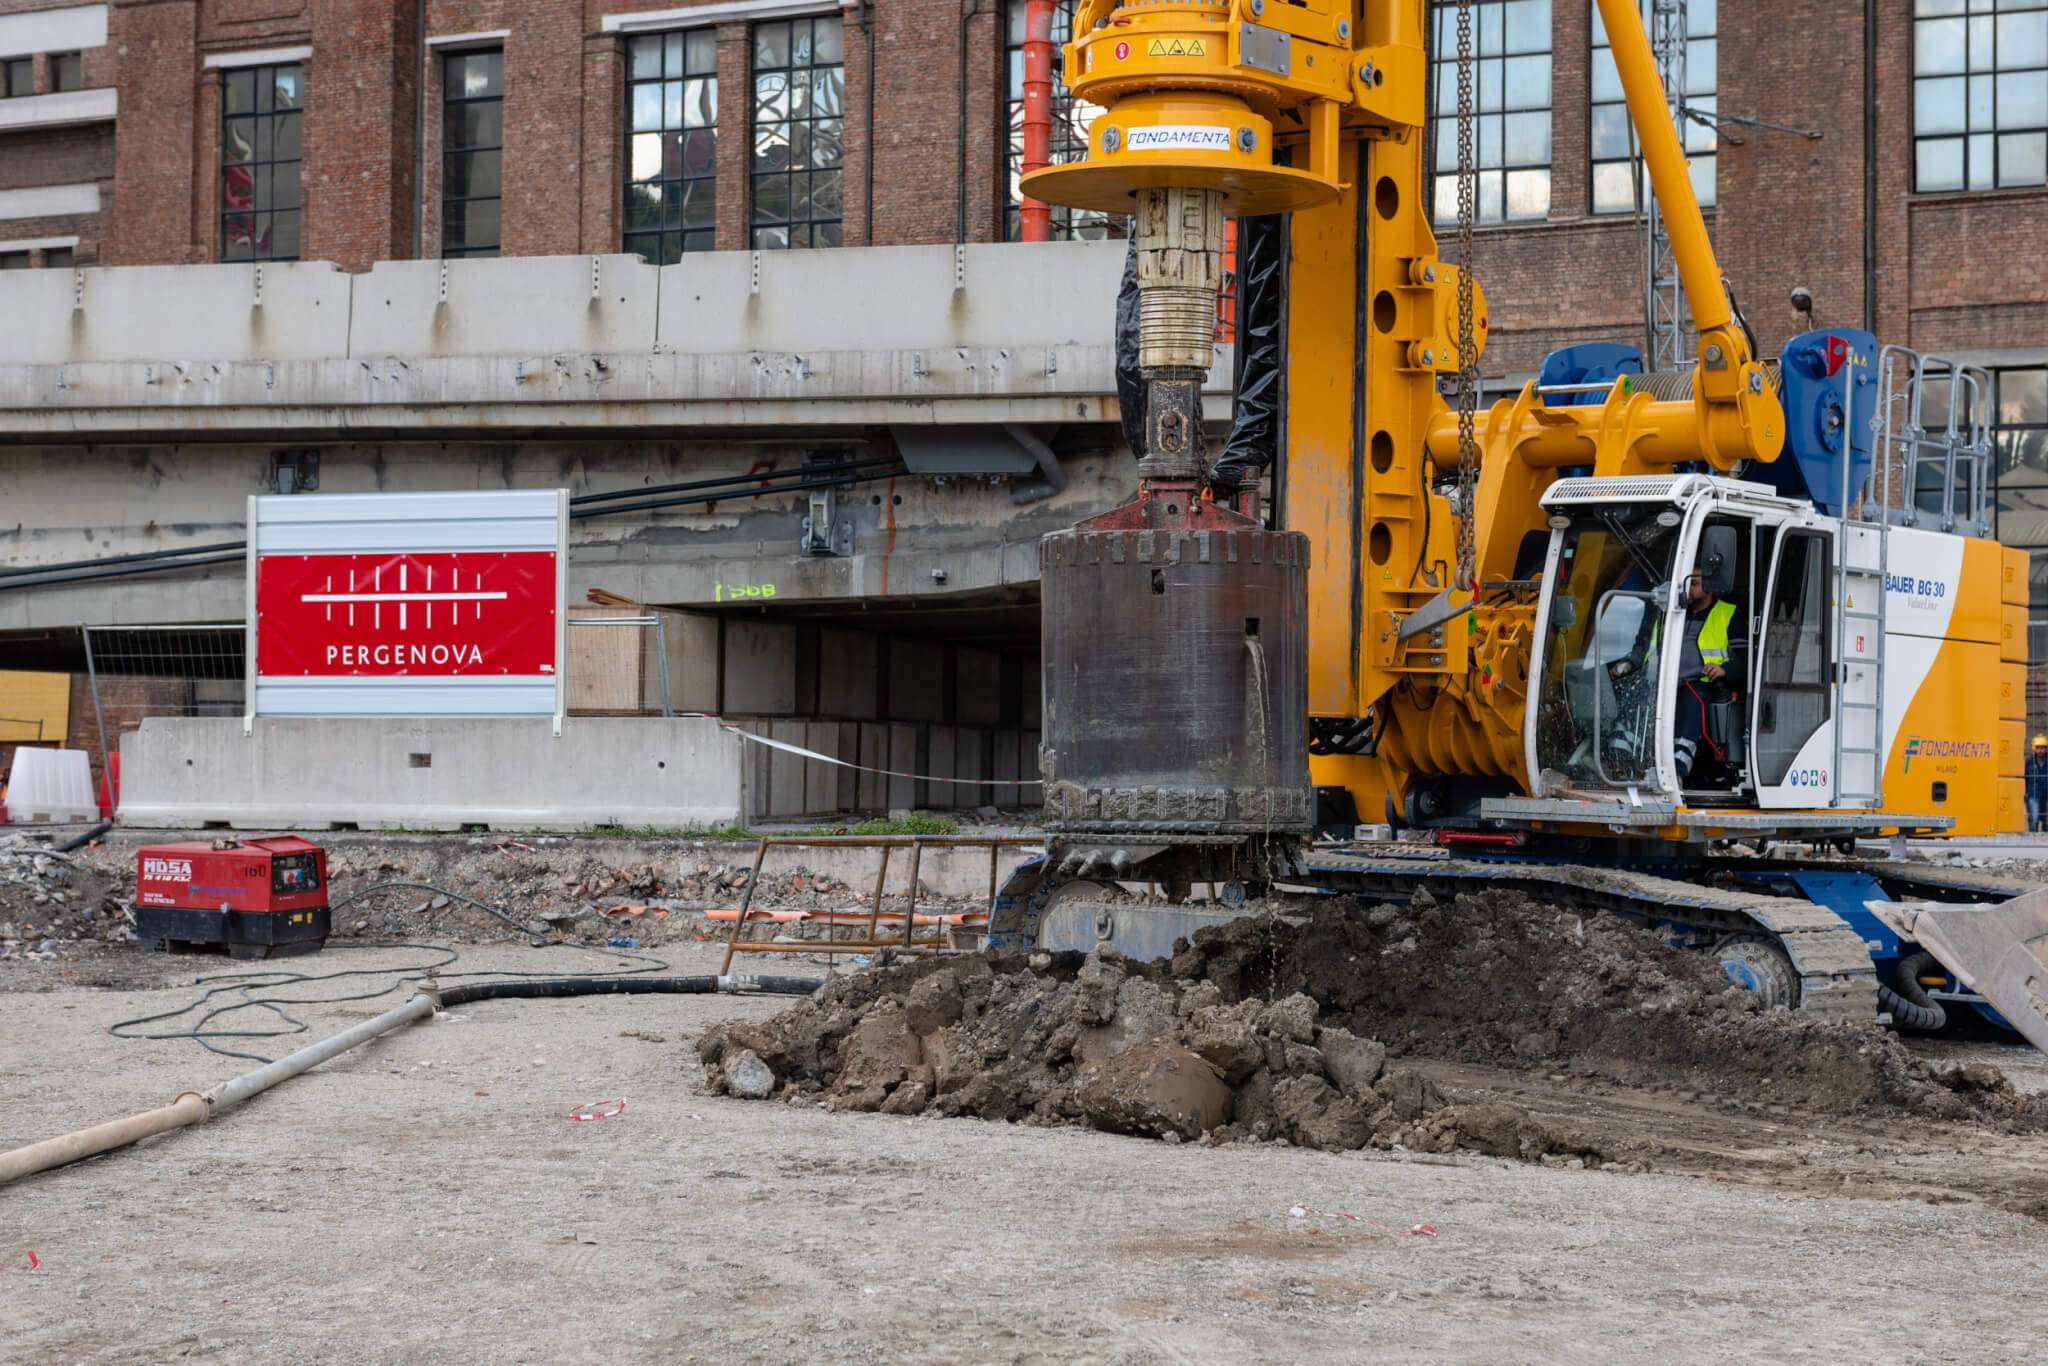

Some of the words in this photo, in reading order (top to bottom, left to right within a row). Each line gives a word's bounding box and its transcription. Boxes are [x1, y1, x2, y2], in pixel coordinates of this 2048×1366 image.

[1127, 131, 1230, 145] FONDAMENTA
[1885, 575, 1914, 594] BAUER
[1918, 579, 1932, 596] BG
[1933, 582, 1945, 598] 30
[326, 644, 483, 665] PERGENOVA
[1920, 740, 1991, 759] FONDAMENTA
[144, 861, 192, 874] MOSA
